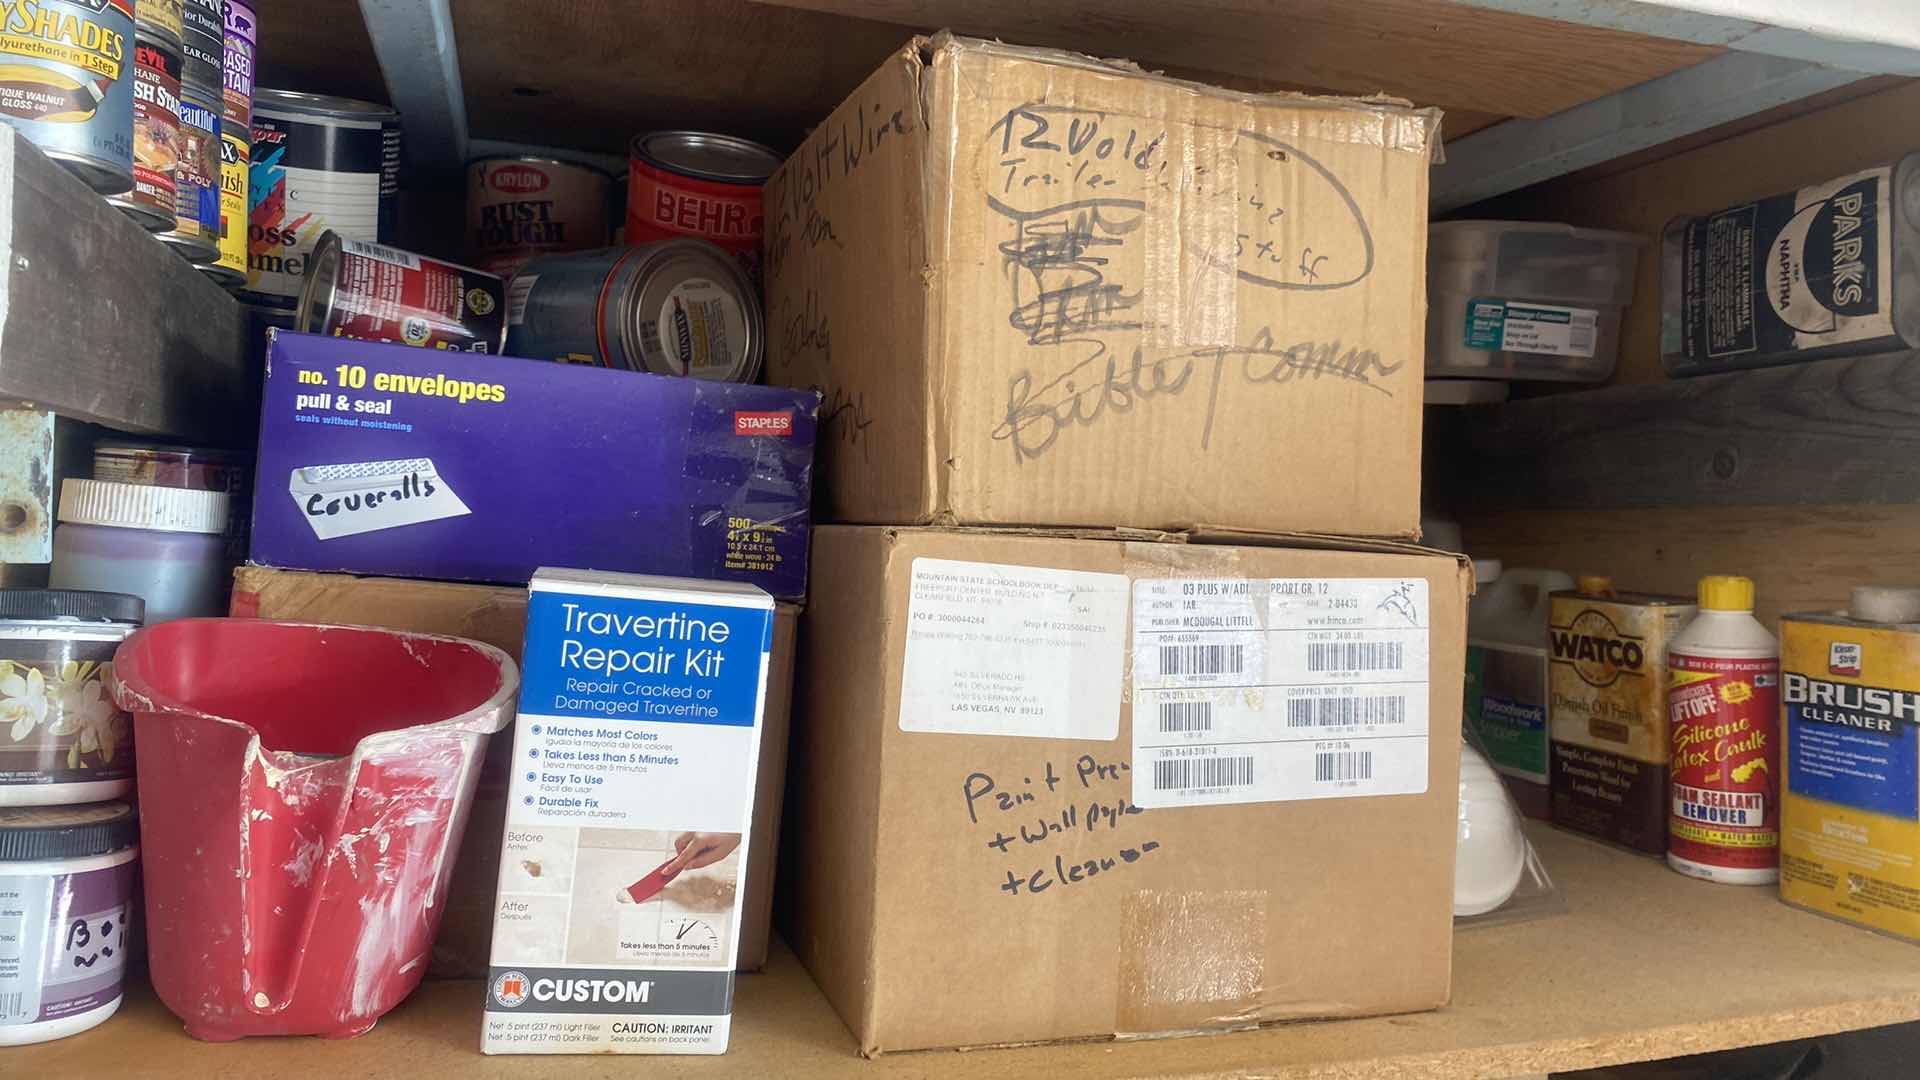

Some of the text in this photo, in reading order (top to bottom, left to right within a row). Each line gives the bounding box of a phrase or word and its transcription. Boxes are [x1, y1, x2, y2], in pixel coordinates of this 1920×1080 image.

[92, 57, 114, 74] Step
[2, 98, 32, 109] GLOSS
[26, 91, 65, 106] WALNUT
[1000, 108, 1061, 155] 12
[495, 171, 542, 189] KRYLON
[481, 200, 554, 224] RUST
[655, 186, 752, 238] BEHR
[1831, 191, 1864, 307] PARKS
[1778, 238, 1791, 312] NAPHTHA
[298, 364, 506, 404] no. 10 envelopes
[295, 393, 392, 415] pull & seal
[295, 413, 413, 433] seals without moistening
[738, 416, 789, 429] STAPLES
[728, 517, 751, 530] 500
[916, 572, 958, 584] MOUNTAIN
[960, 575, 985, 585] STATE
[1183, 583, 1194, 596] 03
[1197, 583, 1218, 596] PLUS
[1301, 583, 1316, 595] GR.
[1318, 583, 1329, 594] 12
[561, 603, 731, 644] Travertine
[913, 611, 926, 621] PO
[1183, 615, 1254, 628] MCDOUGAL LITTELL
[560, 639, 726, 679] Repair Kit
[1550, 631, 1644, 670] WATCO
[566, 678, 713, 701] Repair Cracked or
[1783, 672, 1920, 723] BRUSH
[555, 695, 719, 718] Damaged Travertine
[951, 704, 969, 713] LAS
[1004, 706, 1016, 715] NV
[1802, 705, 1892, 732] CLEANER
[546, 726, 658, 741] Matches Most Colors
[1672, 718, 1751, 753] Silicone
[1714, 730, 1767, 762] Caulk
[544, 750, 679, 765] Takes Less than 5 Minutes
[542, 773, 603, 785] Easy To Use
[539, 796, 599, 808] Durable Fix
[1702, 791, 1761, 809] SEALANT
[1683, 802, 1746, 824] REMOVER
[507, 831, 544, 842] Before
[502, 901, 529, 912] After
[620, 941, 710, 951] Takes less than 5 minutes
[532, 978, 650, 1003] CUSTOM
[489, 1022, 504, 1030] Net
[514, 1023, 530, 1033] pint
[531, 1023, 549, 1032] (237
[564, 1024, 583, 1033] Light
[612, 1022, 713, 1035] CAUTION: IRRITANT
[513, 1034, 529, 1044] pint
[530, 1034, 547, 1043] (237
[563, 1034, 582, 1042] Dark
